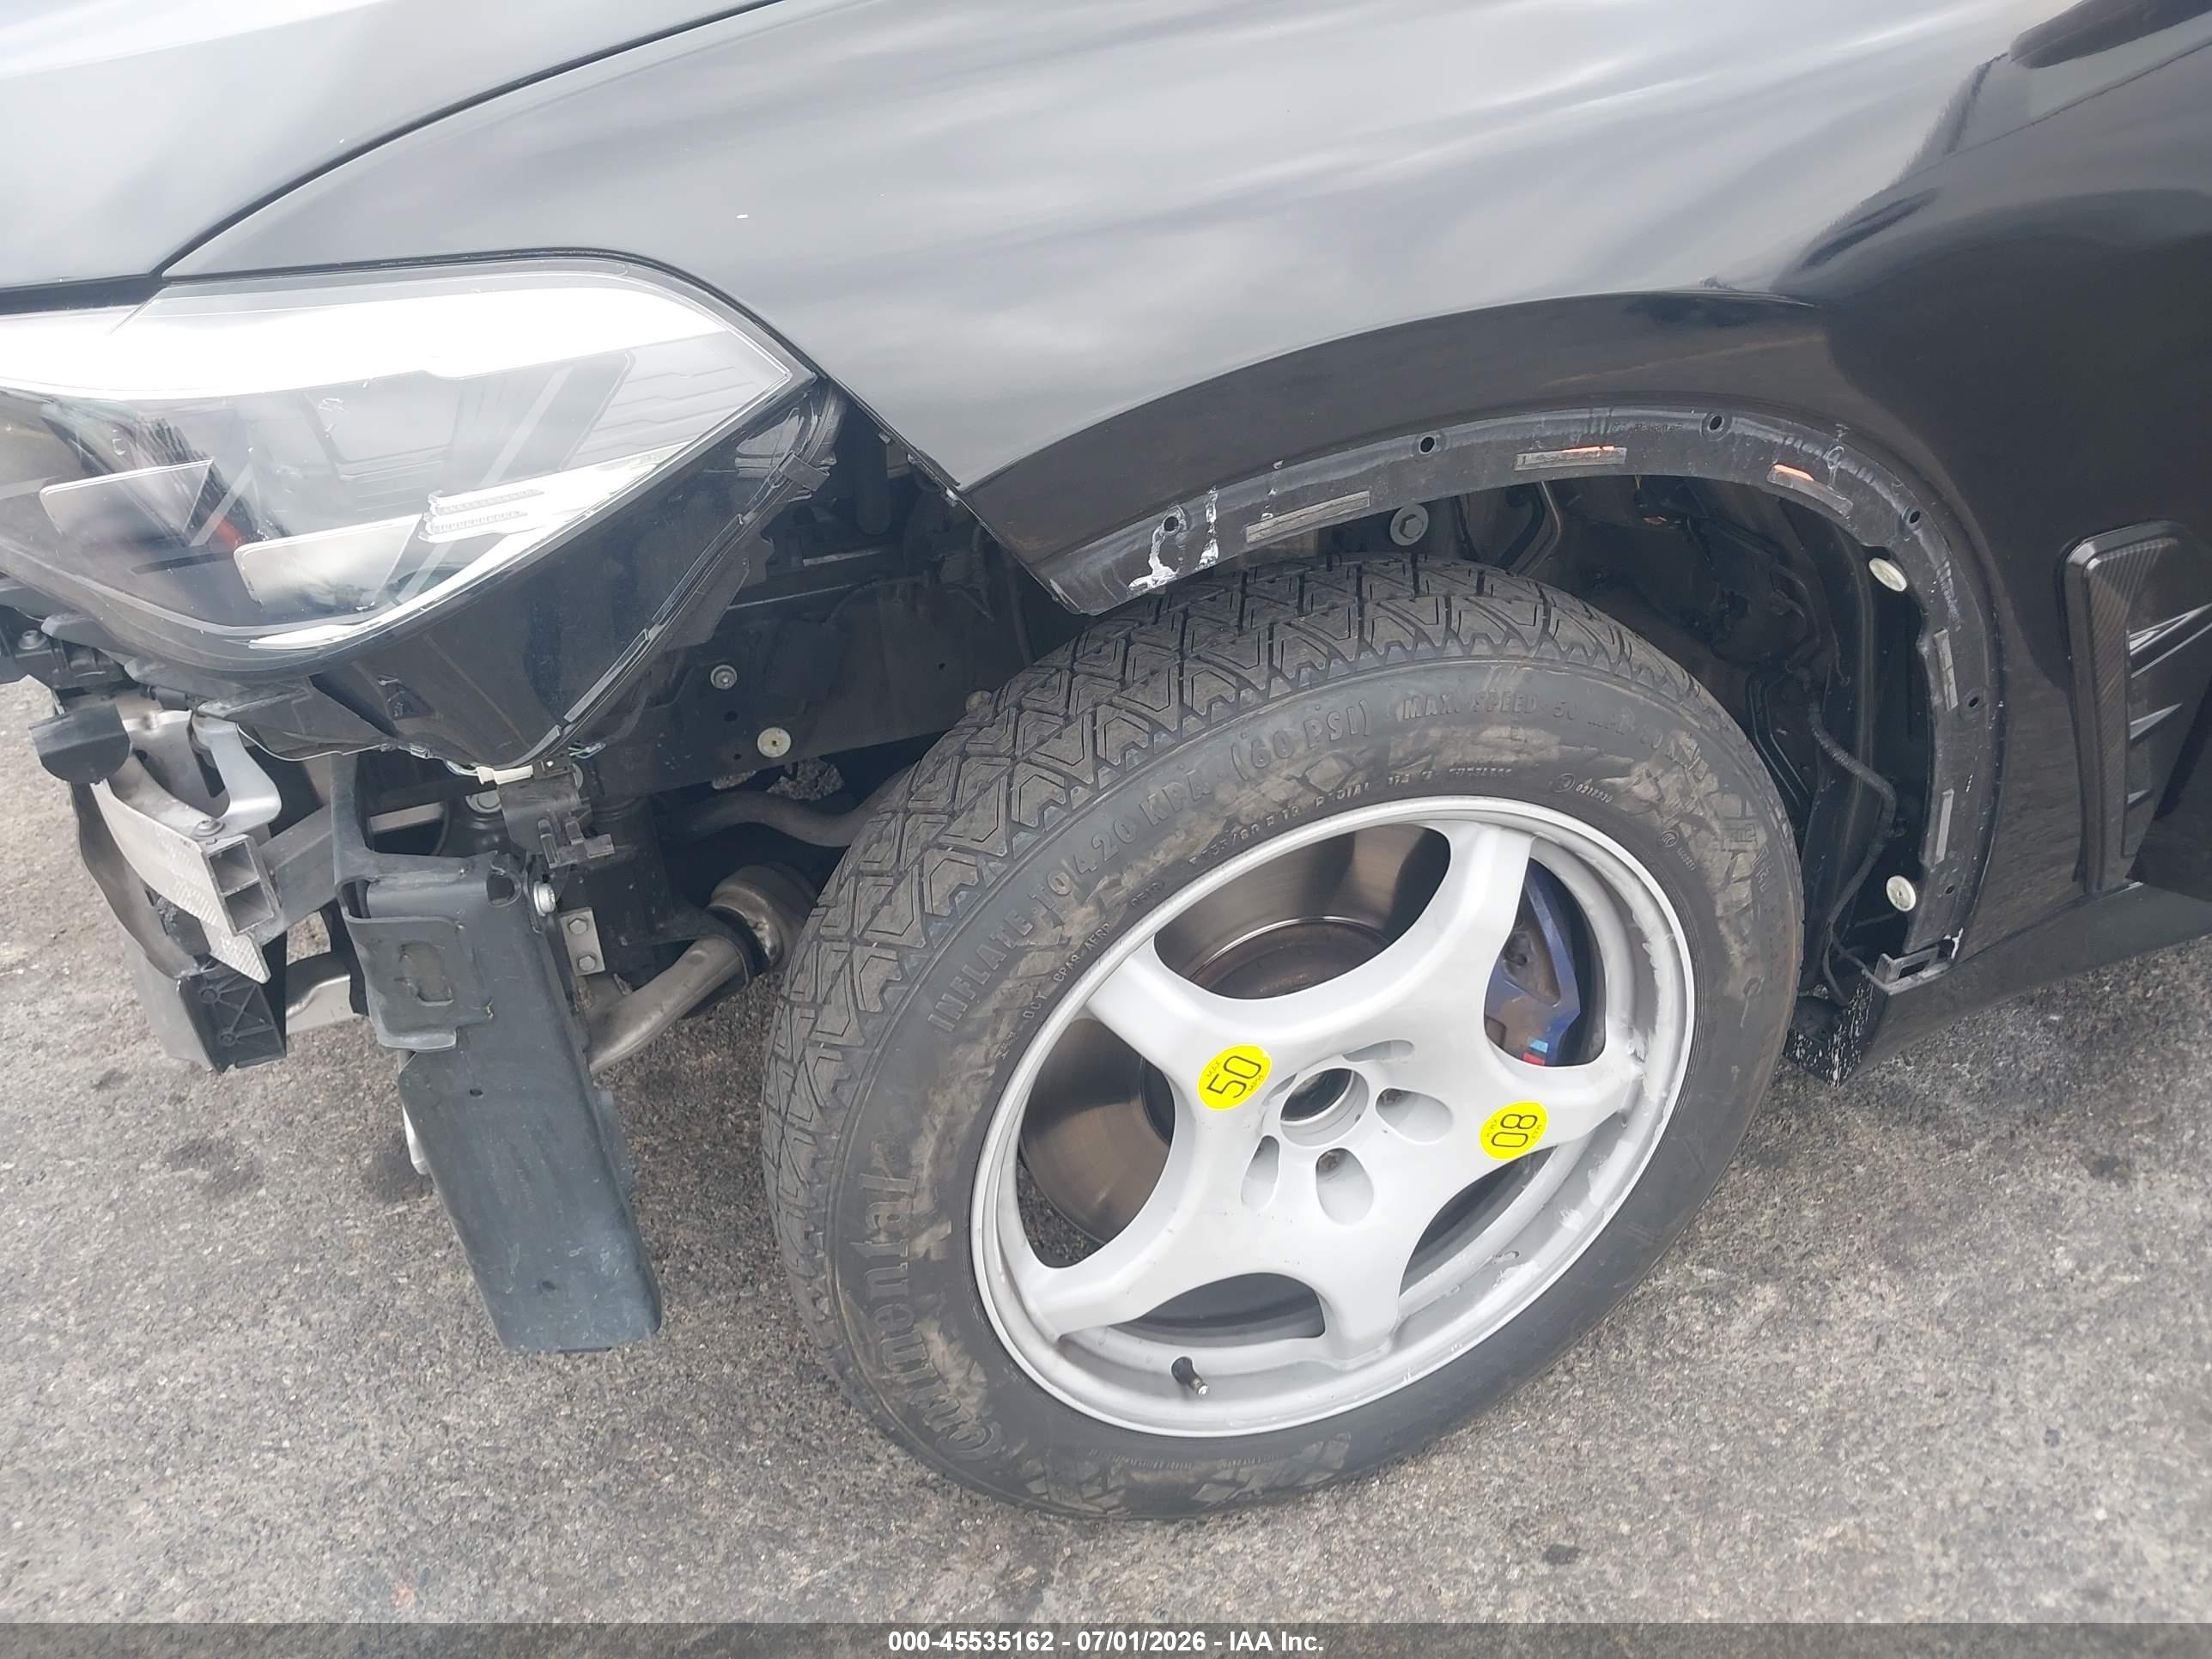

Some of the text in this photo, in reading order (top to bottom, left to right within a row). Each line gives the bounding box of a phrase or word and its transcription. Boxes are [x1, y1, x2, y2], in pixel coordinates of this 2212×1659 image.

[927, 699, 1370, 1032] INFLATE TO 420 KPA (60 PSI)
[1206, 1055, 1261, 1099] 50
